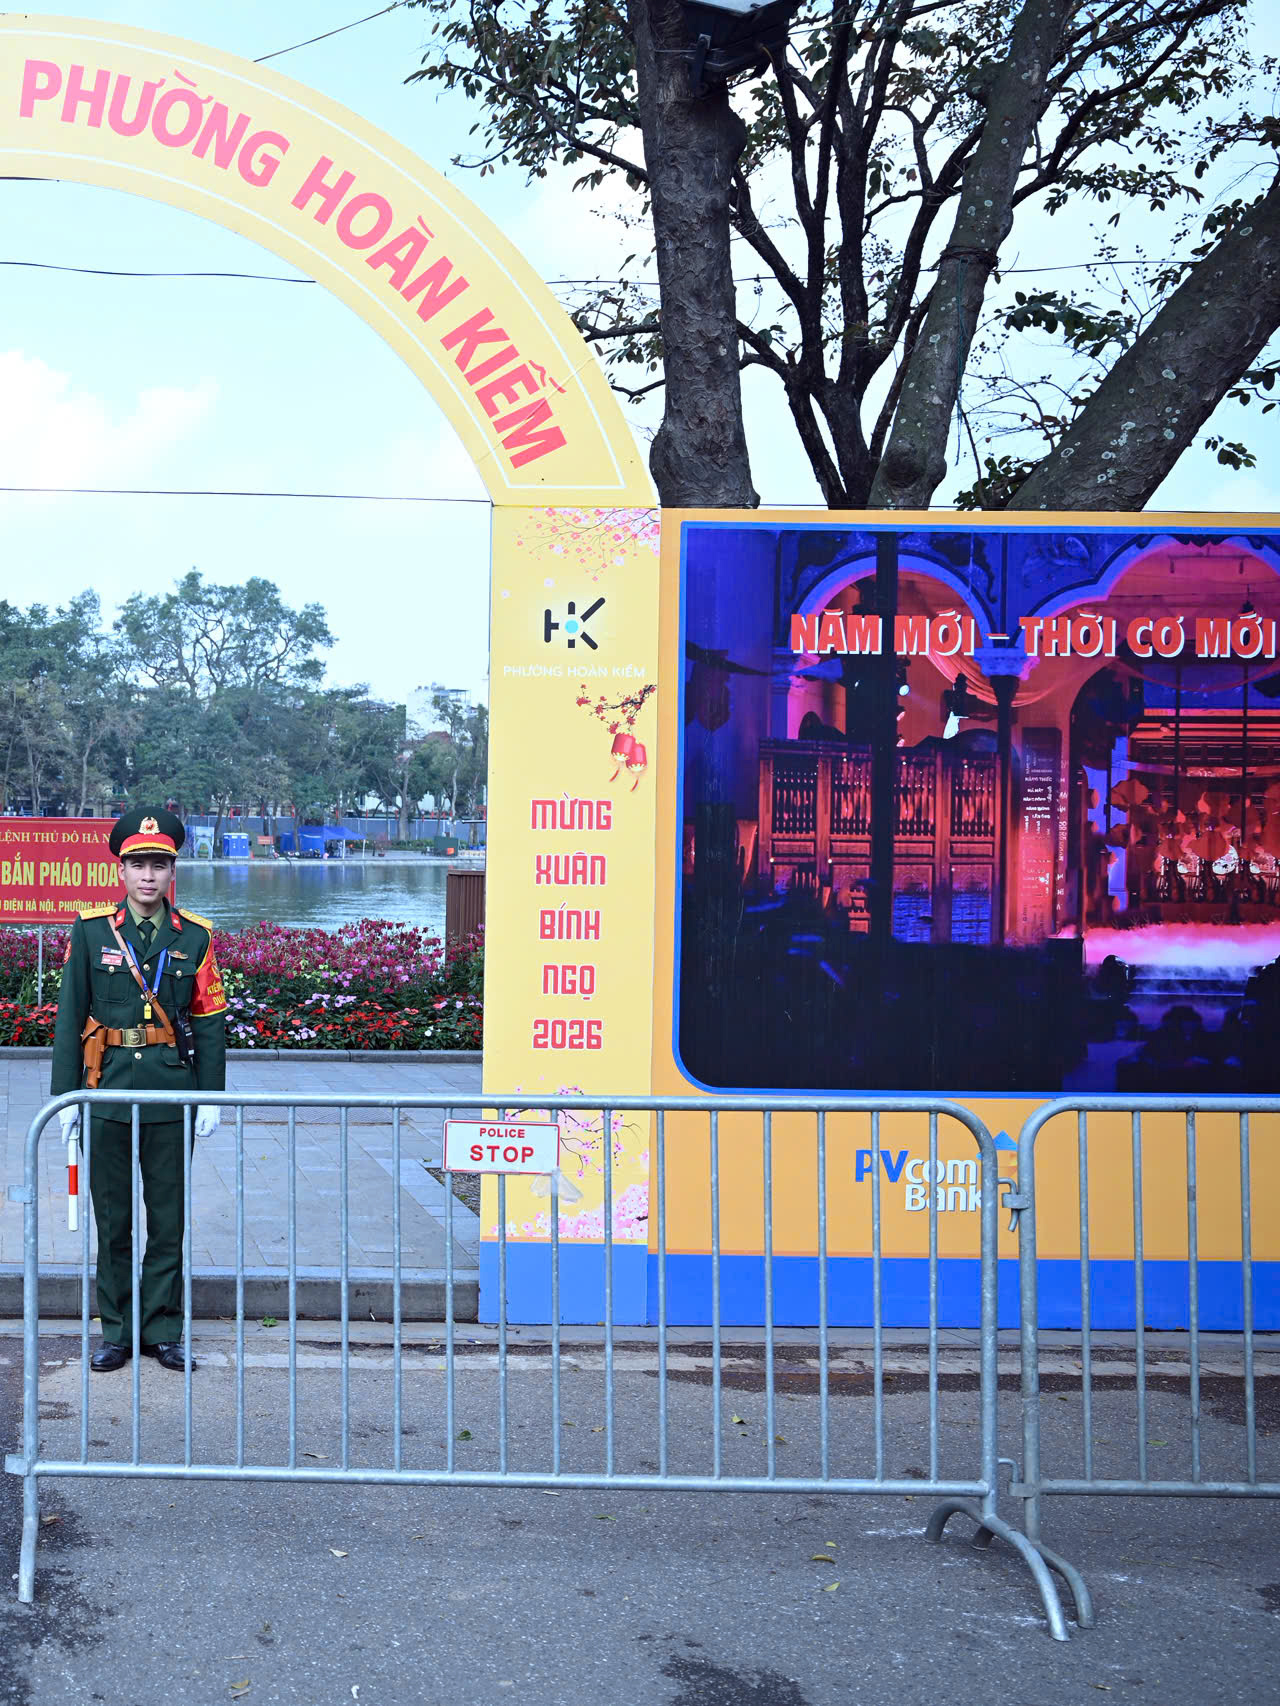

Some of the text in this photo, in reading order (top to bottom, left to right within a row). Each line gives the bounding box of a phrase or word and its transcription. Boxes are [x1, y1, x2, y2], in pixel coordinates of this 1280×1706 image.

[19, 59, 290, 188] PHƯỜNG
[290, 156, 470, 323] HOÀN
[440, 307, 567, 469] KIẾM
[791, 608, 883, 654] NĂM
[893, 607, 975, 656] MỚI
[1019, 608, 1116, 656] THỜI
[1126, 615, 1184, 657] CƠ
[1195, 609, 1276, 658] MỚI
[531, 792, 612, 830] MỪNG
[33, 829, 58, 843] THỦ
[61, 830, 79, 843] ĐÔ
[82, 830, 100, 843] HÀ
[2, 852, 35, 887] BẮN
[39, 857, 82, 887] PHÁO
[87, 862, 119, 887] HOA
[536, 852, 606, 885] XUÂN
[540, 902, 600, 940] BÍNH
[543, 965, 595, 1000] NGỌ
[533, 1019, 602, 1049] 2026
[479, 1127, 525, 1138] POLICE
[470, 1144, 534, 1163] STOP
